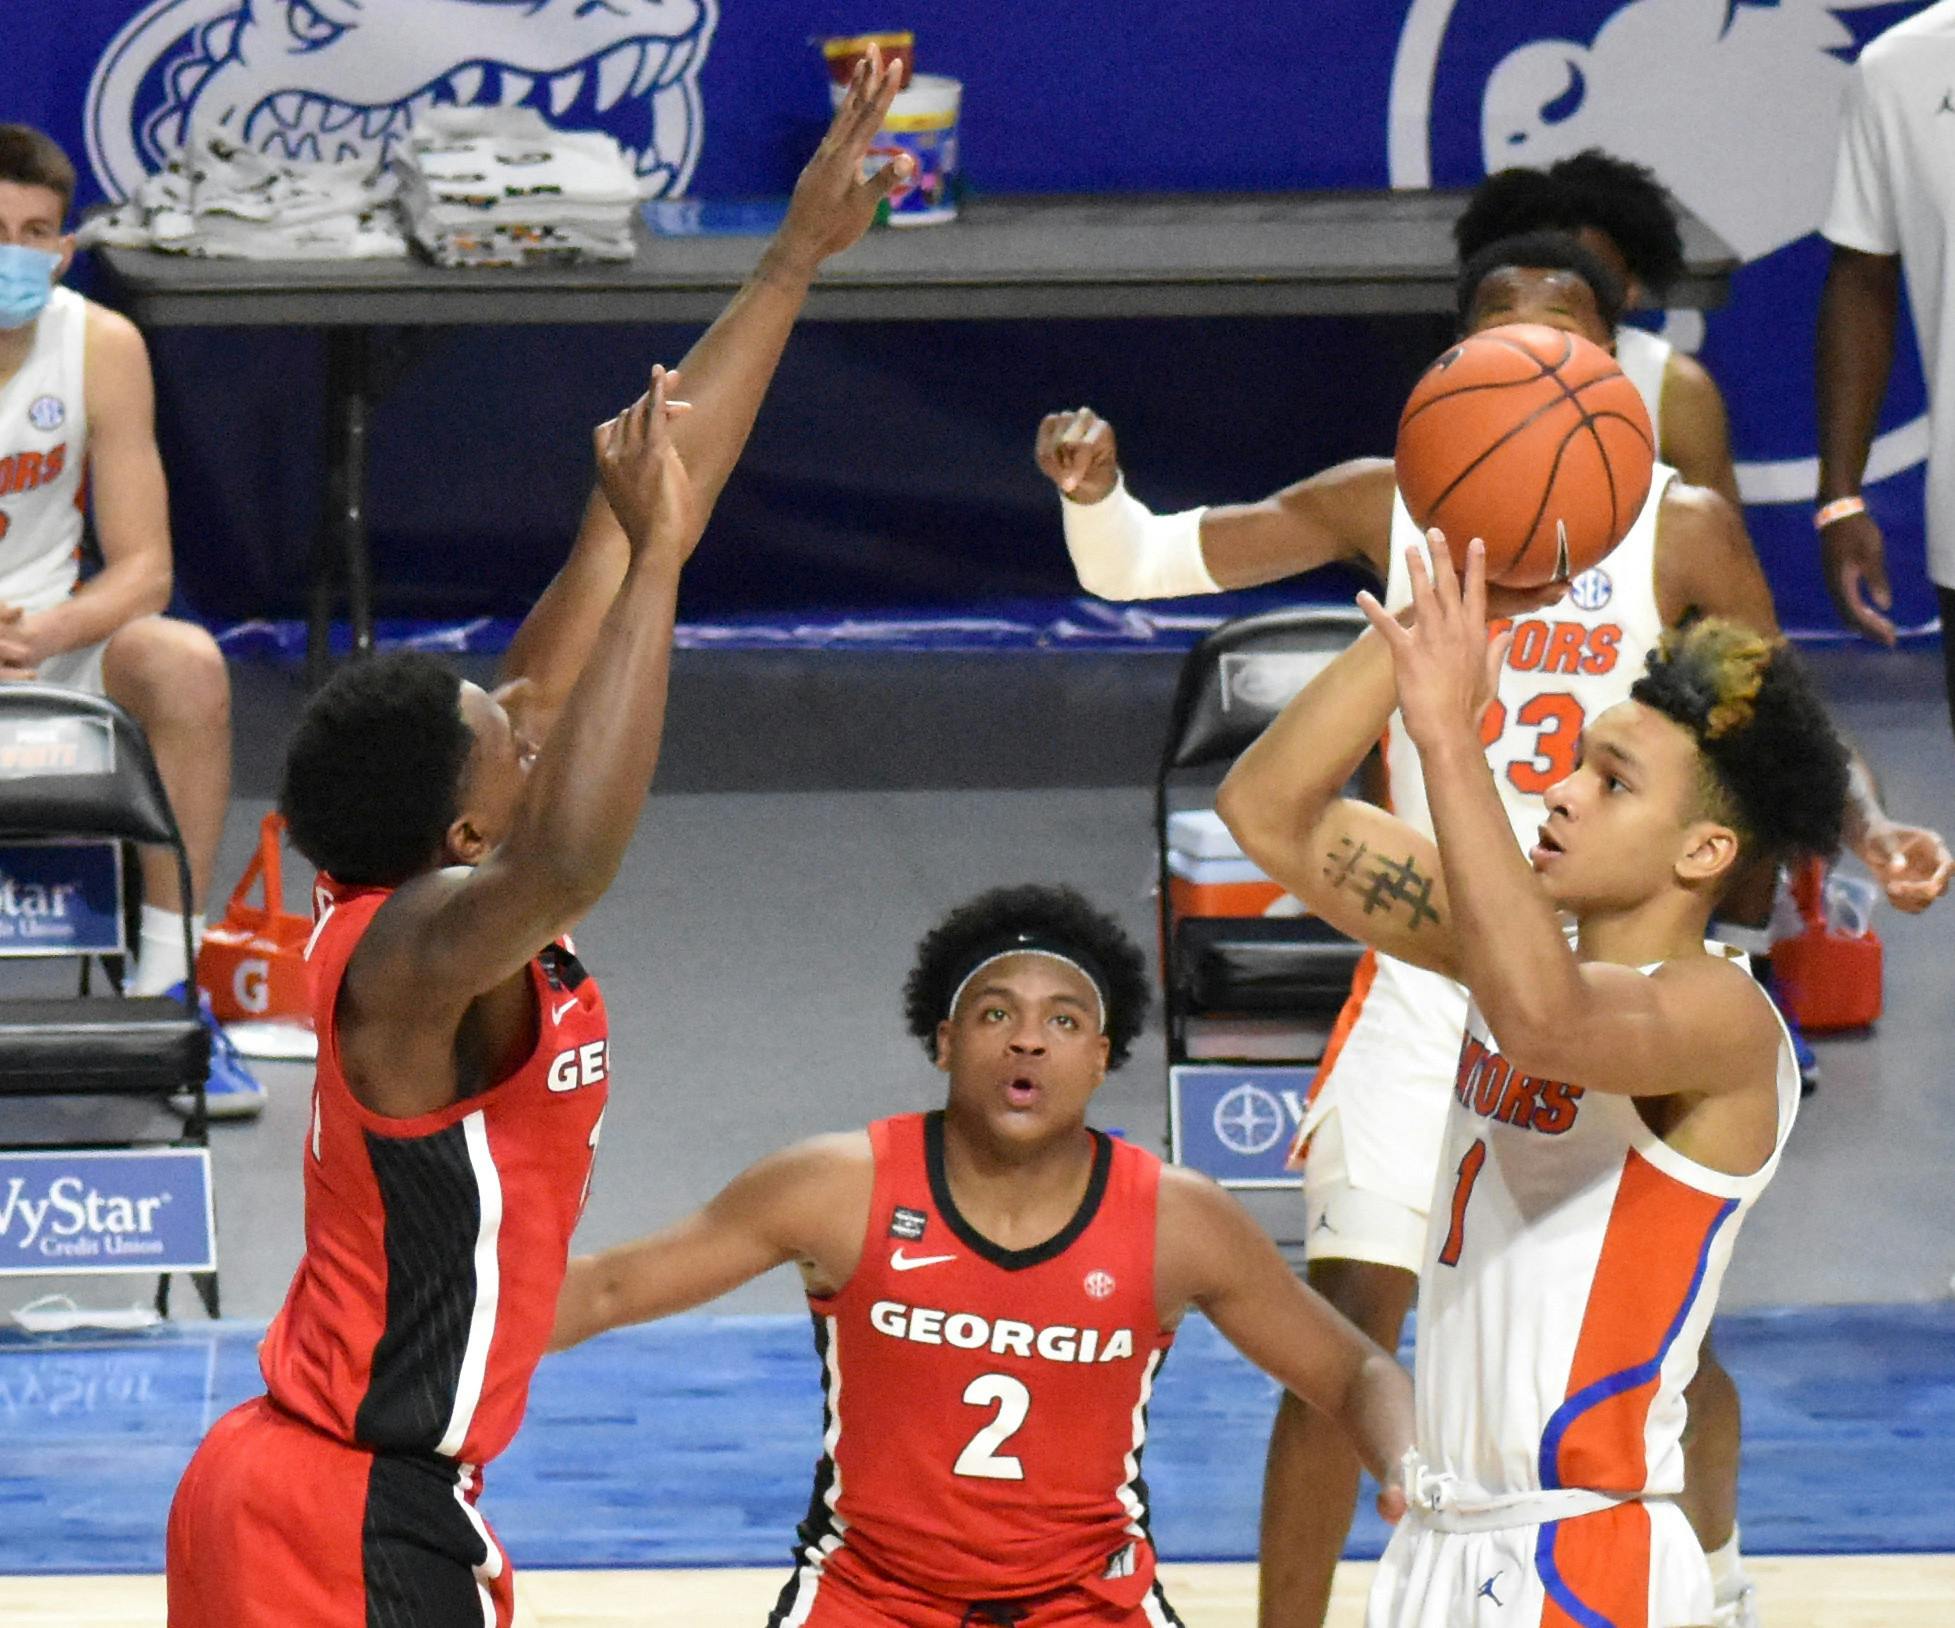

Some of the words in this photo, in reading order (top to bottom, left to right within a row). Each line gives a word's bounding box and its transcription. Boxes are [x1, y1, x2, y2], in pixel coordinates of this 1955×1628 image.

[0, 877, 75, 917] tar
[234, 959, 269, 1014] G
[547, 1040, 609, 1093] GE
[1437, 1138, 1486, 1268] 1
[104, 1234, 164, 1255] Union
[868, 1299, 1134, 1365] GEORGIA
[952, 1372, 1031, 1481] 2
